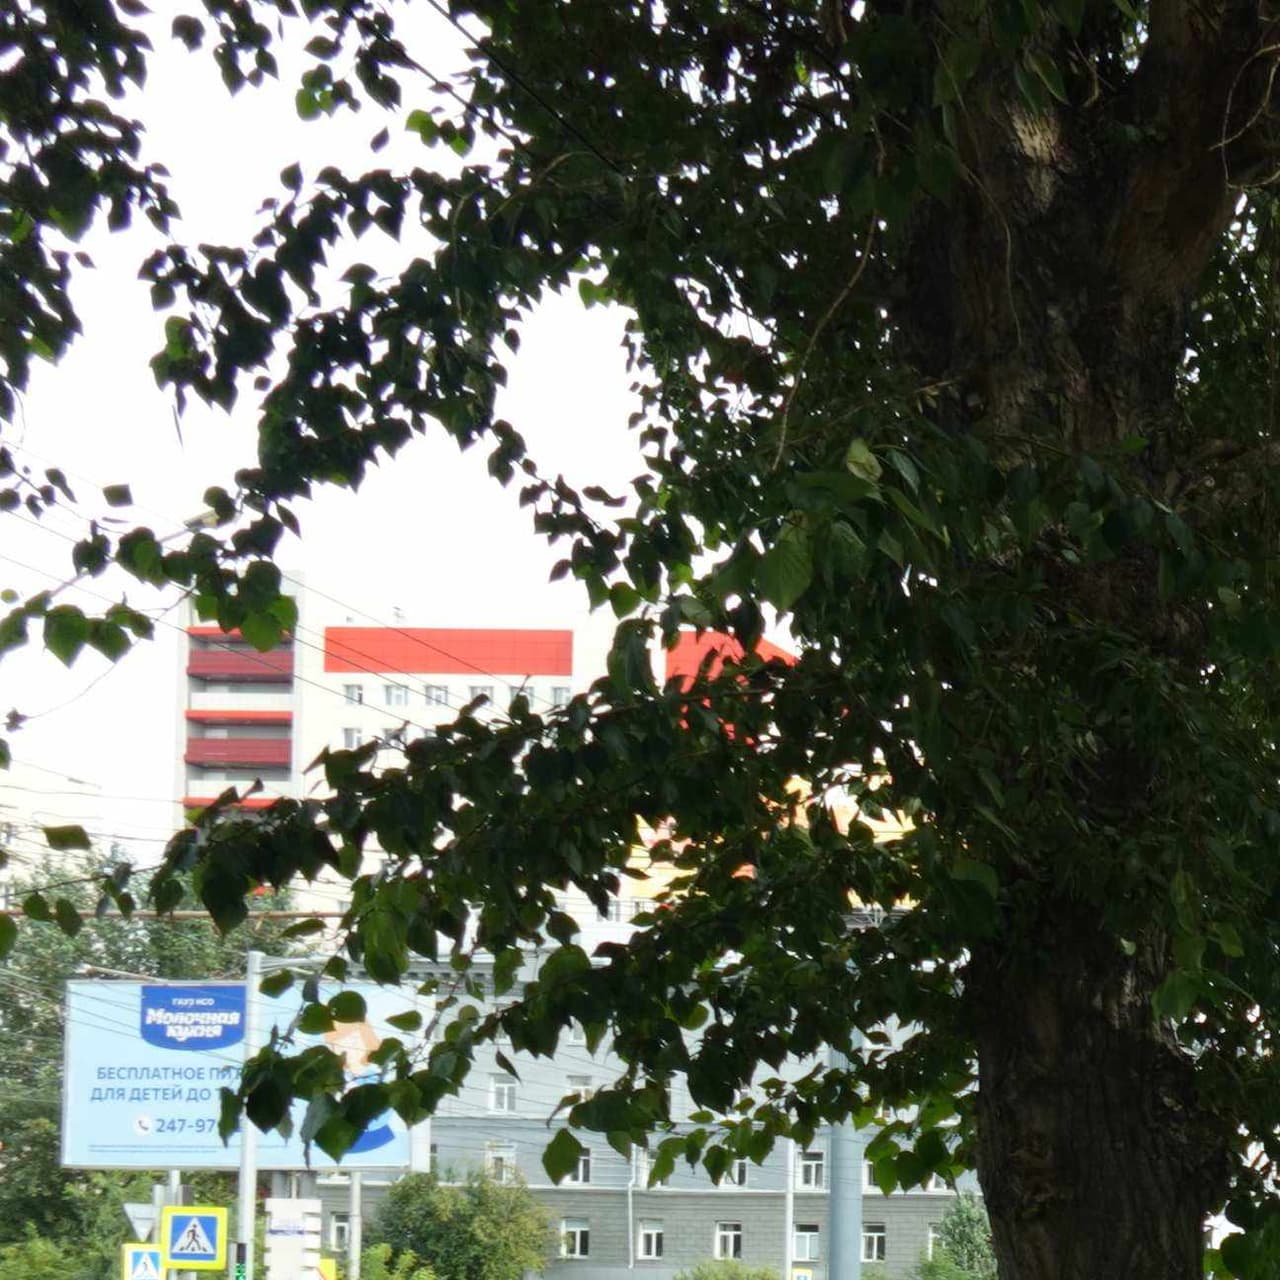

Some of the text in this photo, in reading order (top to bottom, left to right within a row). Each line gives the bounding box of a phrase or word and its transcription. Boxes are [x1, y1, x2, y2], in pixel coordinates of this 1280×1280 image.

[145, 1009, 241, 1025] Молочная
[97, 1067, 205, 1080] БЕСПЛАТНОЕ
[90, 1088, 125, 1102] ДЛЯ
[130, 1085, 182, 1102] ДЕТЕЙ
[186, 1088, 212, 1102] ДО
